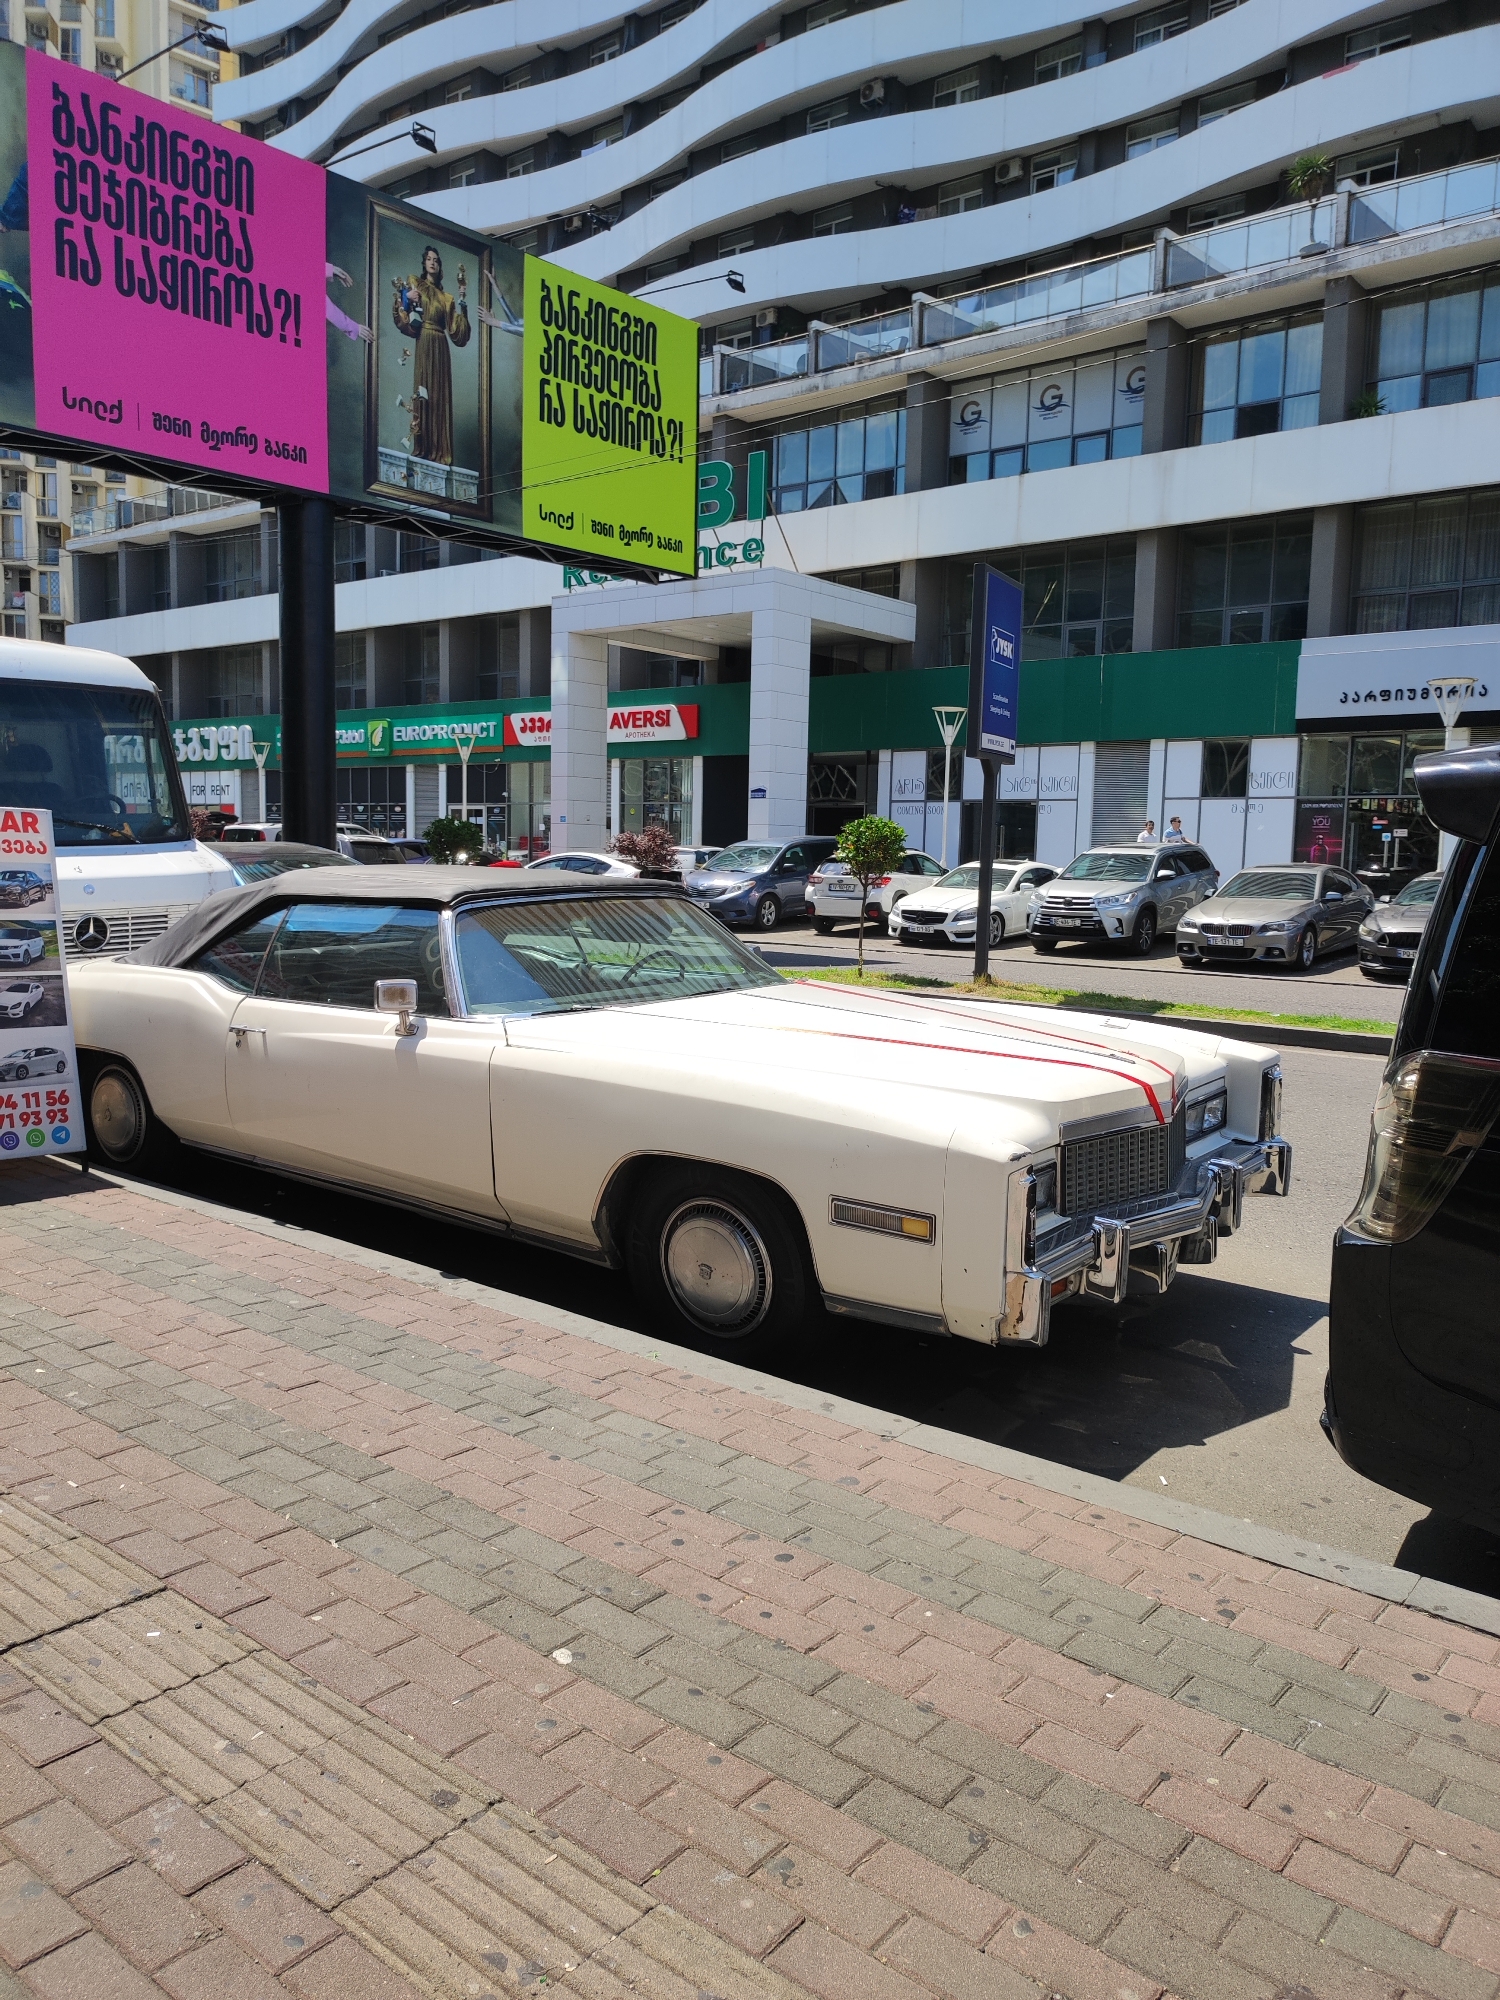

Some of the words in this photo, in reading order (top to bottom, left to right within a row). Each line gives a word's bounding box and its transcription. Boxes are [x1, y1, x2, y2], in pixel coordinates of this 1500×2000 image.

[52, 82, 254, 216] ბანკინგში
[52, 149, 254, 274] შეჯიბრება
[55, 218, 101, 287] რა
[540, 279, 657, 365] ბანკინგში
[539, 329, 661, 412] პირველობა
[539, 378, 564, 427] რა
[152, 412, 191, 438] შენი
[264, 438, 307, 464] ბანკი
[697, 450, 768, 531] BI
[591, 519, 614, 538] შენი
[657, 535, 683, 553] ბანკი
[996, 638, 1013, 659] JYSK
[393, 722, 497, 741] EUROPRODUCT
[610, 710, 671, 730] AVERSI
[625, 731, 655, 739] APOTHEKA
[192, 785, 206, 797] FOR
[211, 785, 230, 796] RENT
[897, 805, 924, 816] COMING
[1312, 817, 1331, 826] YOU
[21, 1092, 41, 1108] 11
[46, 1089, 70, 1107] 56
[19, 1111, 43, 1127] 93
[46, 1108, 69, 1125] 93
